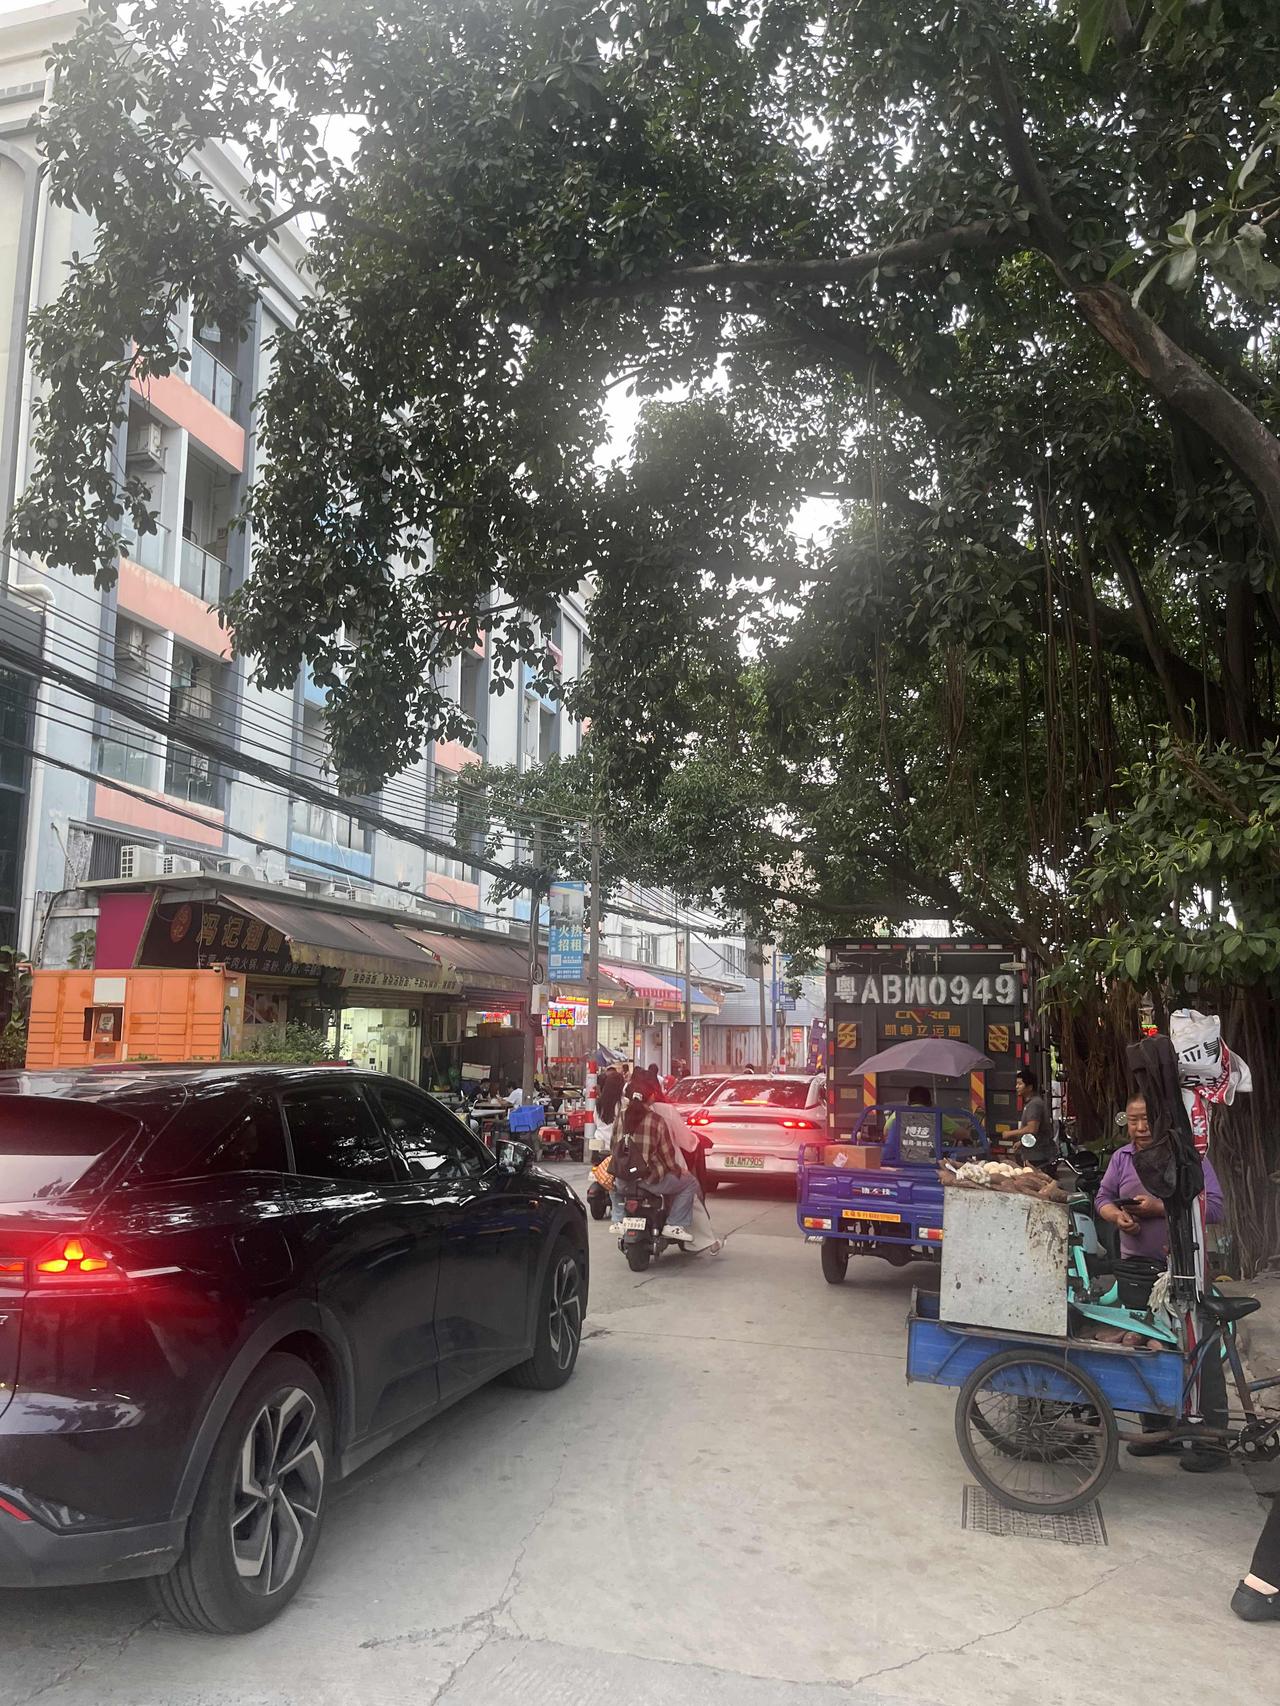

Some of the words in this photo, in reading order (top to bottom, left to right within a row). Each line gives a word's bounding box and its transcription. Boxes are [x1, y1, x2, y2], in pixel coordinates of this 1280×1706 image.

[558, 924, 582, 938] 火热
[558, 938, 582, 952] 招租
[834, 974, 1016, 1004] 粤ABW0949
